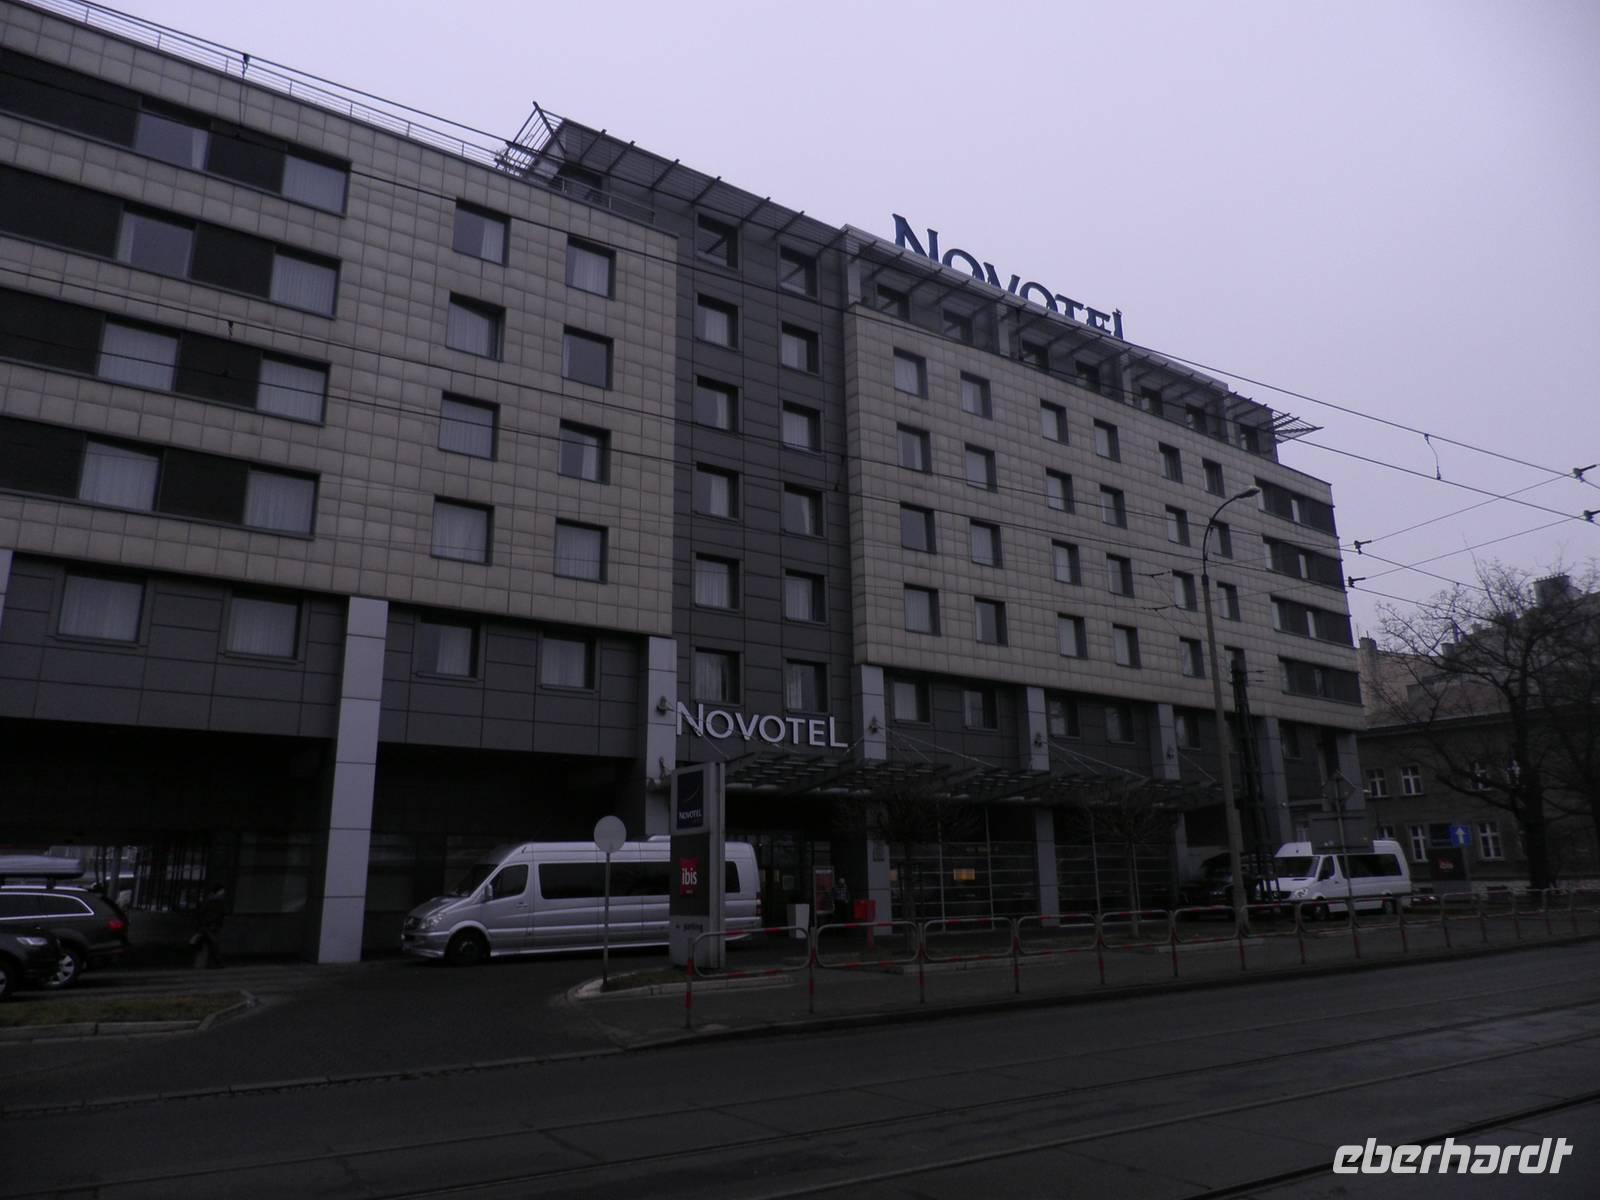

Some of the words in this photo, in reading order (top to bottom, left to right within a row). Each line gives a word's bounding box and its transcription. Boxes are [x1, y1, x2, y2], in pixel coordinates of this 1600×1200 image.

[676, 701, 848, 748] NOVOTEL
[679, 808, 702, 820] NOVOTEL
[681, 867, 698, 885] ibis
